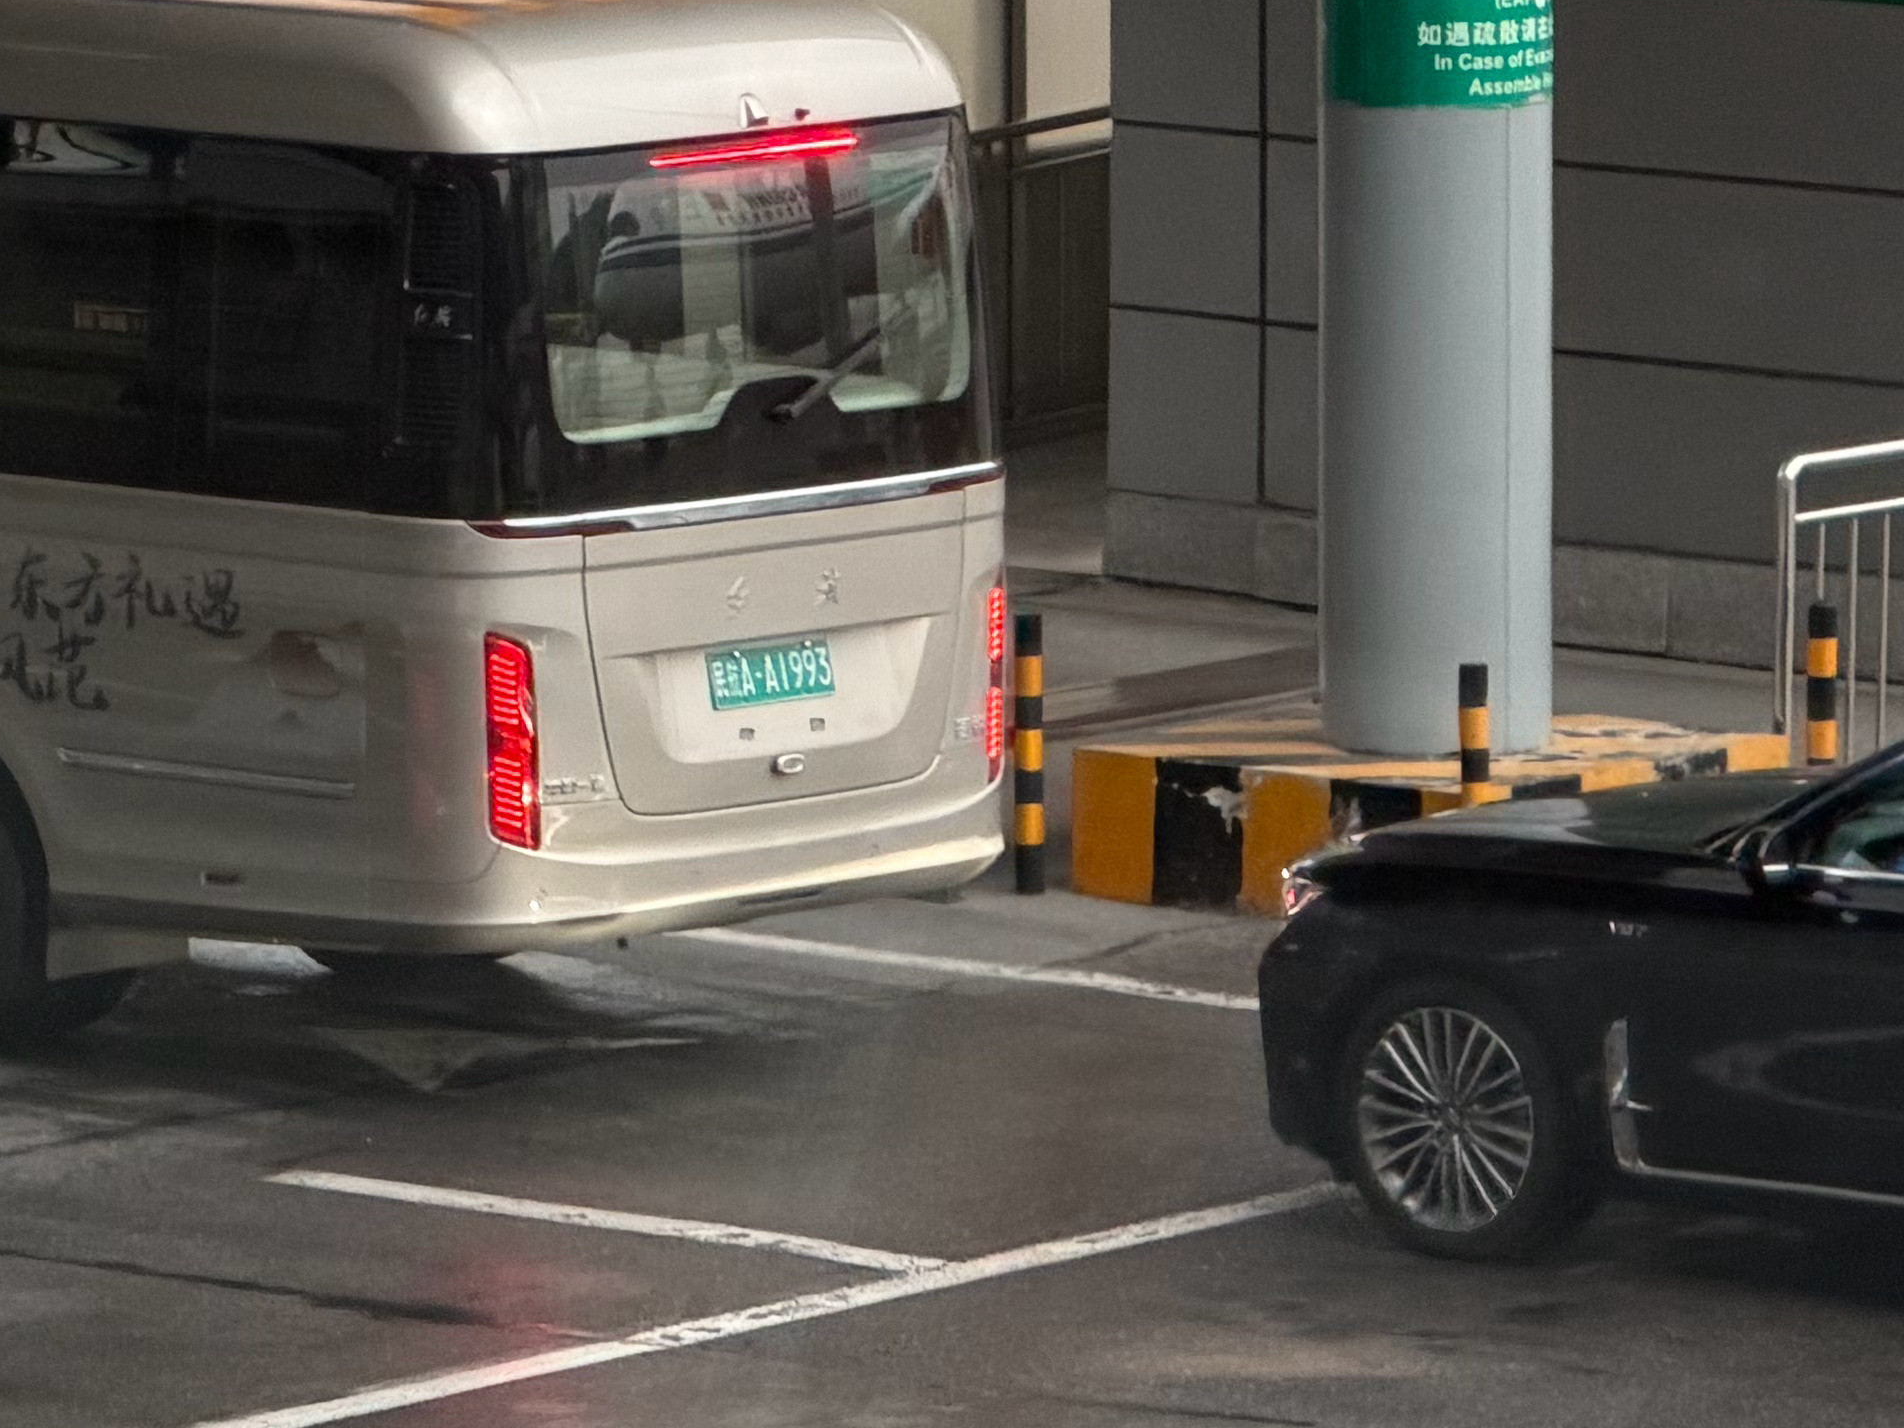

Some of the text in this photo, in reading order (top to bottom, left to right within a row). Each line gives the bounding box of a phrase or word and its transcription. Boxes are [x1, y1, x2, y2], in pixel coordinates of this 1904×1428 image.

[1434, 52, 1453, 71] In
[1458, 51, 1505, 71] Case
[1508, 50, 1526, 69] of
